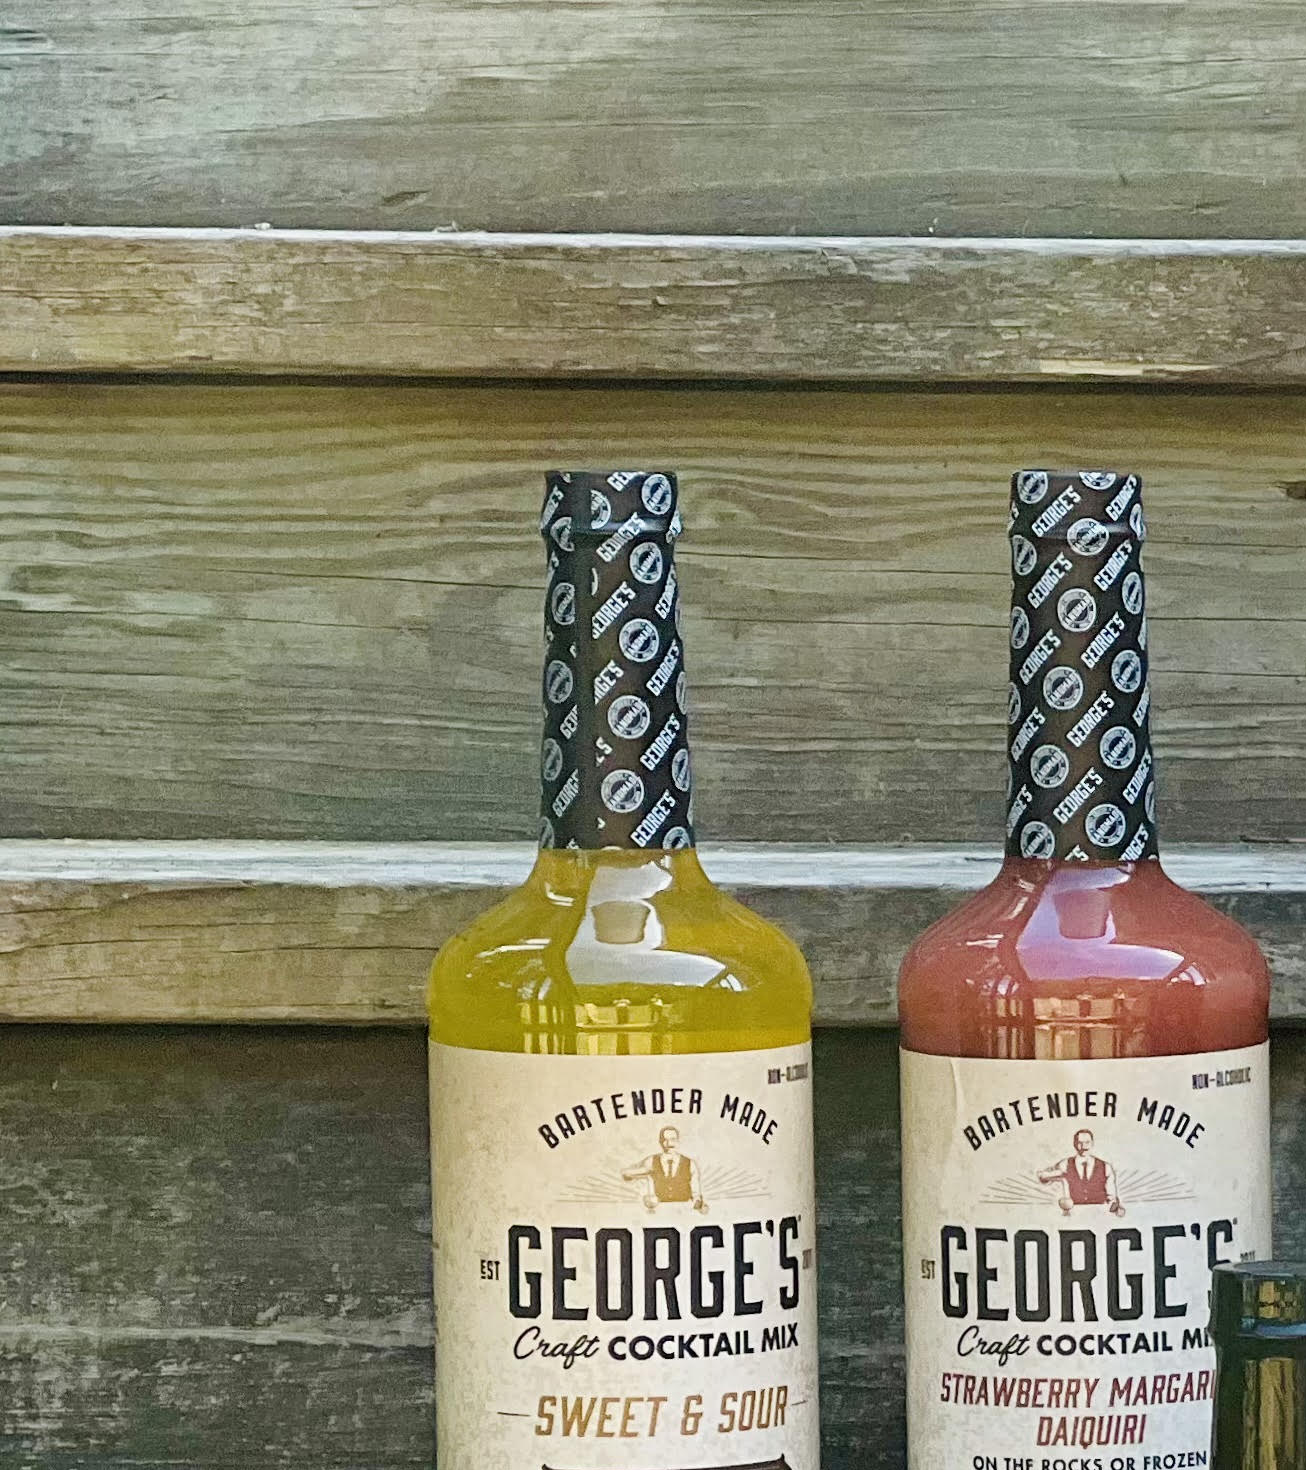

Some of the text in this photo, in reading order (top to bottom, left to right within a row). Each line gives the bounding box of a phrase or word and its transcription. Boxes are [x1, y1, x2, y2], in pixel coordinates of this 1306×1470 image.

[537, 1088, 779, 1149] BARTENDER MADE
[964, 1091, 1205, 1150] BARTENDER MADE
[480, 1216, 800, 1321] EST GEORGE'S
[513, 1322, 798, 1370] Craft COCKTAIL MIX
[957, 1325, 1172, 1366] Craft COCKTAIL
[535, 1386, 787, 1437] SWEET & SOUR
[940, 1373, 1099, 1408] STRAWBERRY
[1036, 1414, 1147, 1449] DAIQUIRI
[1144, 1451, 1207, 1470] FROZEN
